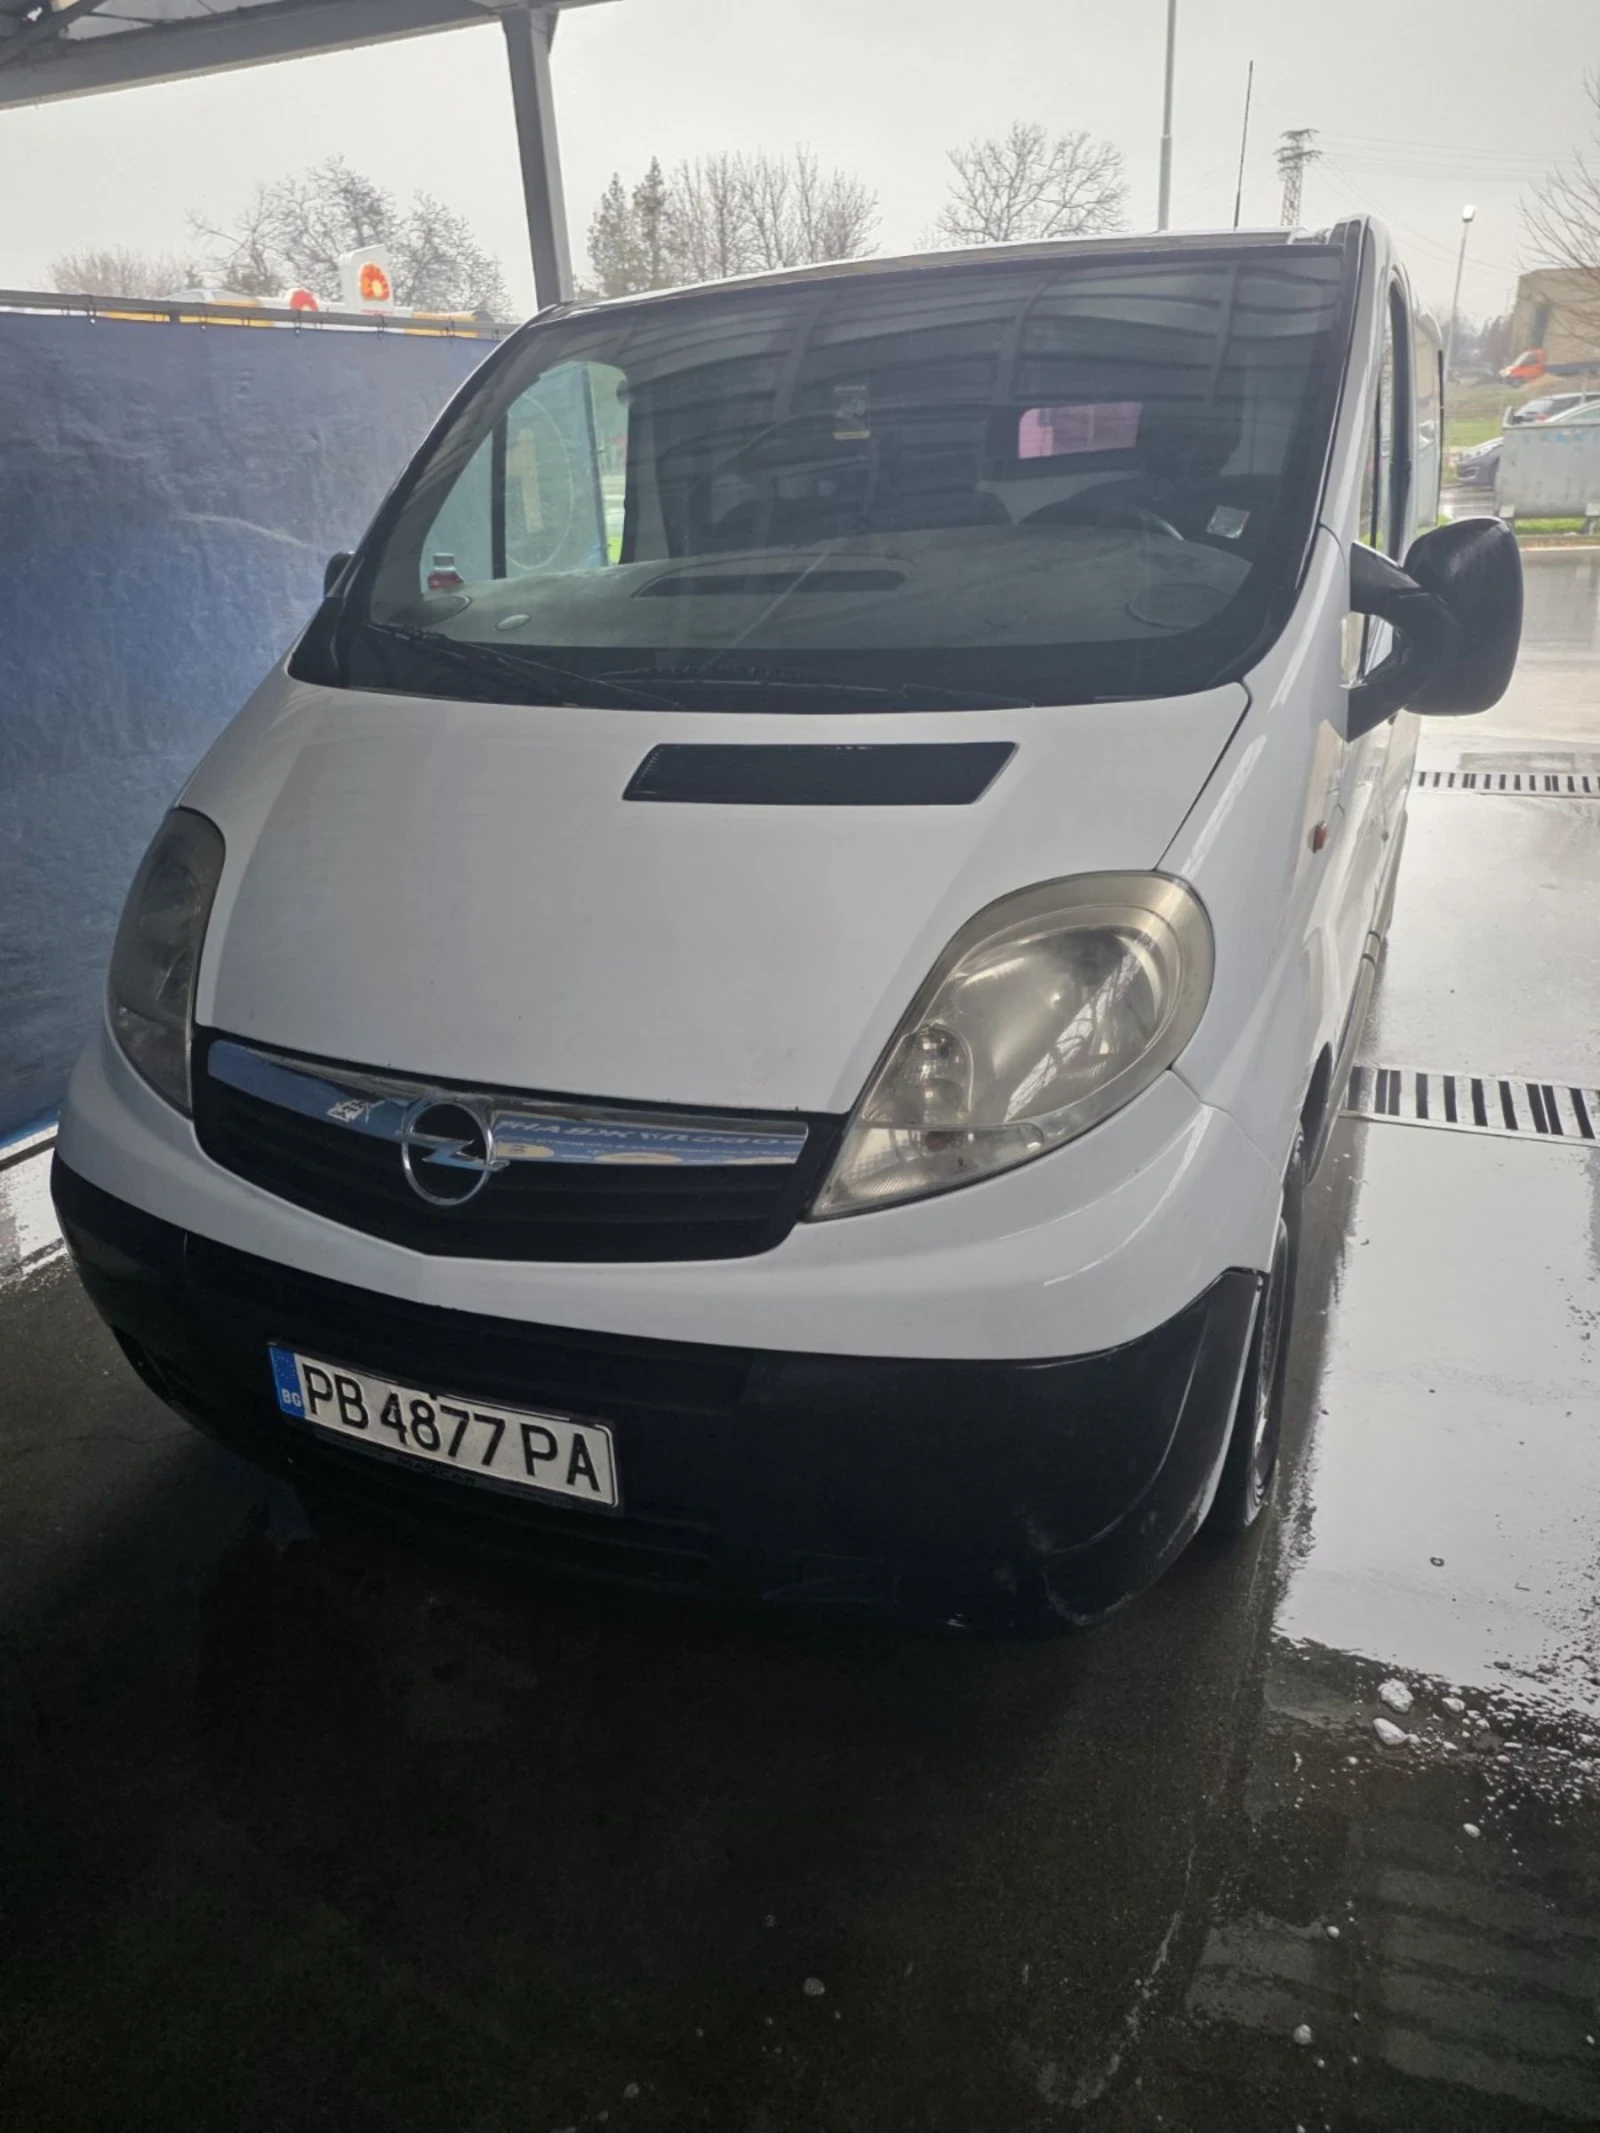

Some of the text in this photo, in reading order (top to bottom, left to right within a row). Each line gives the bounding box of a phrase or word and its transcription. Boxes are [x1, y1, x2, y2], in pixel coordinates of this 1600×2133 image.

[281, 1388, 302, 1407] BG
[302, 1363, 369, 1430] PB
[380, 1392, 506, 1467] 4877
[520, 1423, 602, 1493] PA
